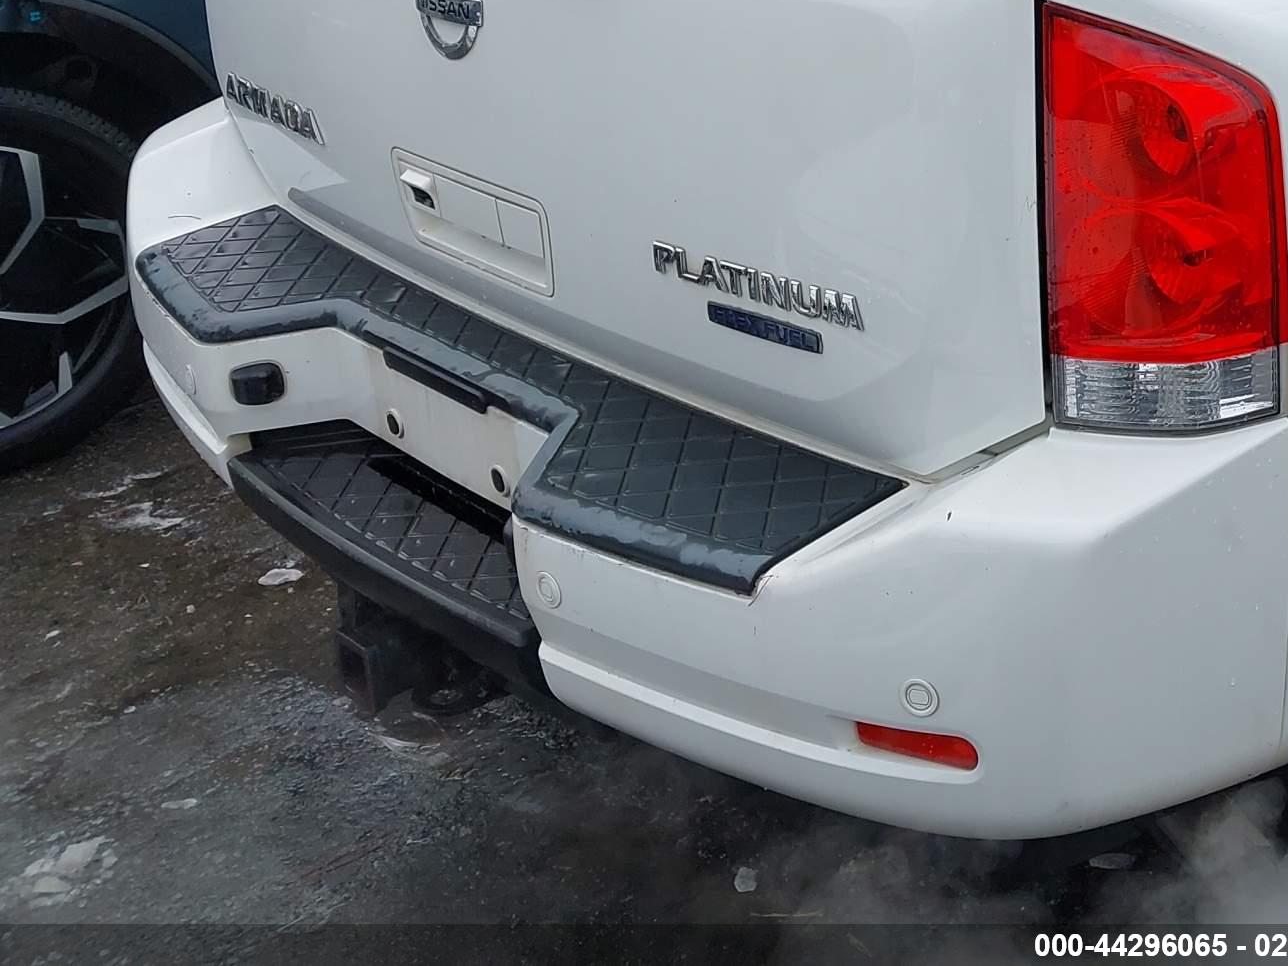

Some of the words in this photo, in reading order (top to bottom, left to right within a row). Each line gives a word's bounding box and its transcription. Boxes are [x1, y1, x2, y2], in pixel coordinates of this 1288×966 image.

[226, 71, 325, 145] ARMADA
[652, 239, 865, 332] PLATINUM
[763, 320, 814, 348] FUEL
